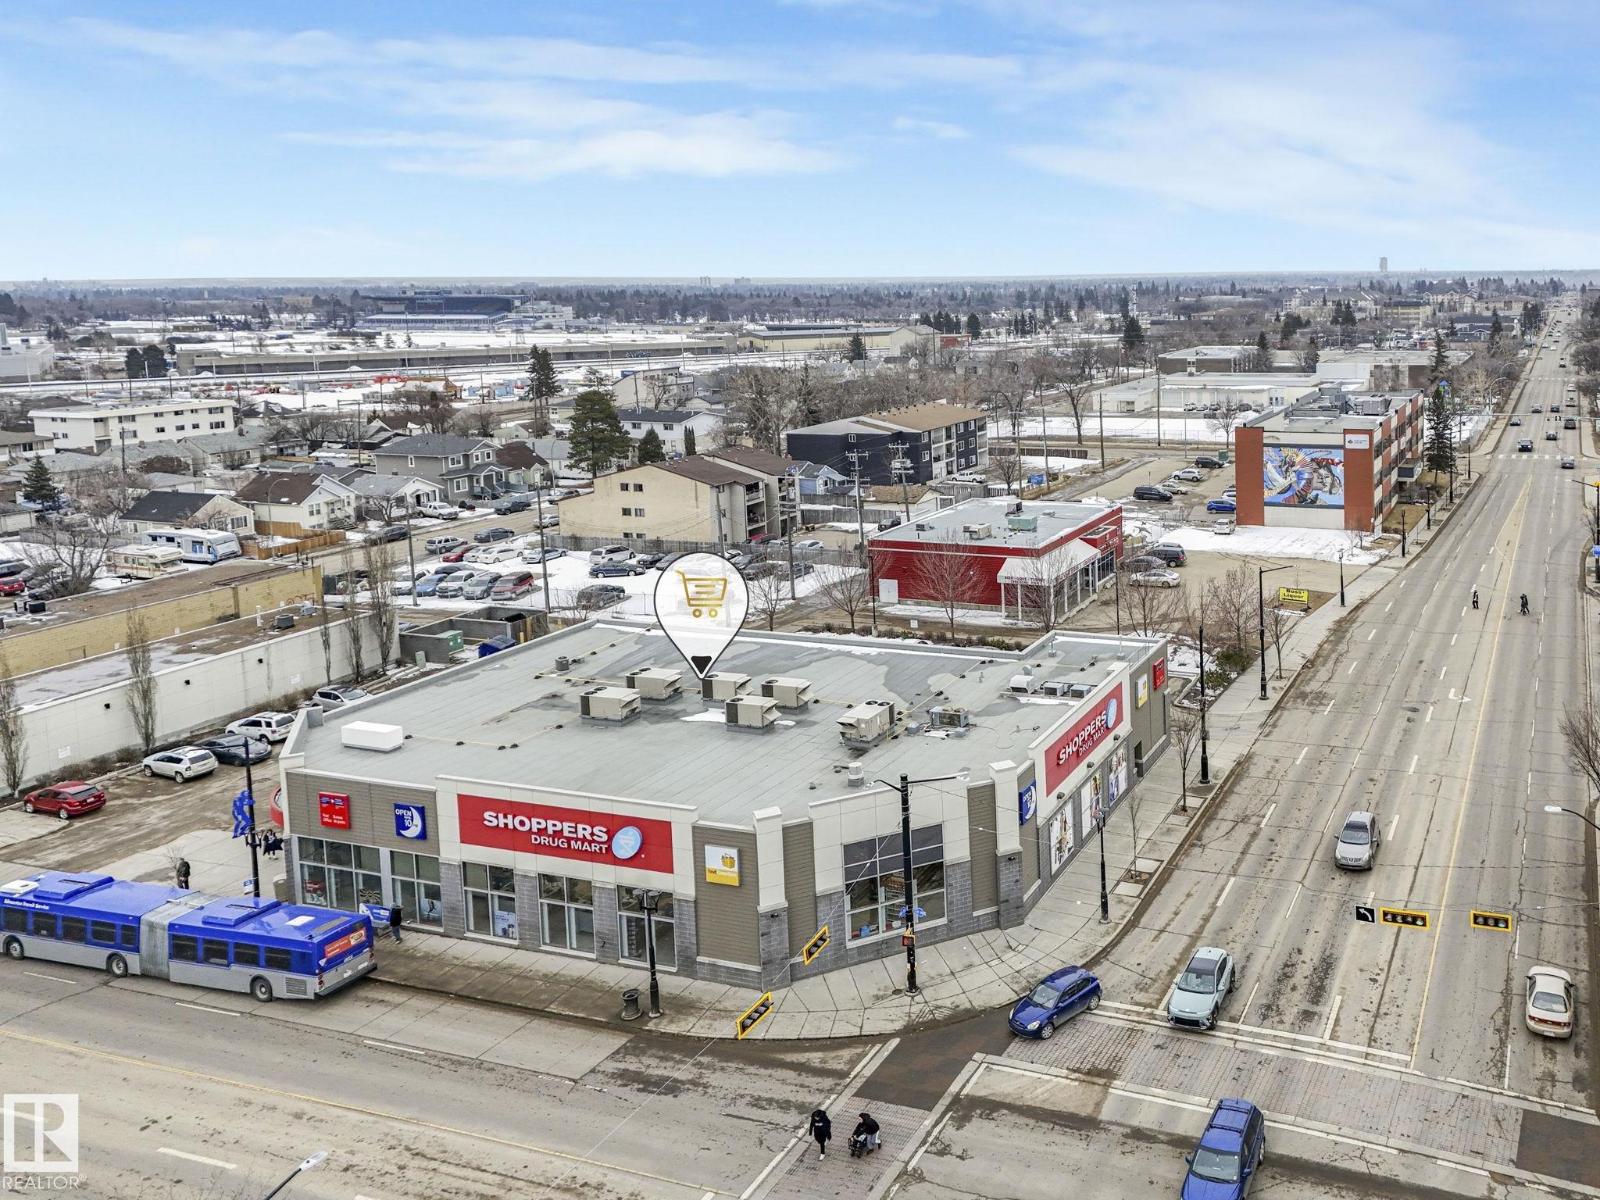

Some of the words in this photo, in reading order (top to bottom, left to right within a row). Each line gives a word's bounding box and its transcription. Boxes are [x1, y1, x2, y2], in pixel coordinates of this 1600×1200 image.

[1059, 710, 1106, 765] SHOPPERS
[395, 808, 412, 816] OPEN
[404, 819, 412, 827] 10
[483, 811, 608, 842] SHOPPERS
[531, 834, 568, 849] DRUG
[571, 839, 608, 854] MART
